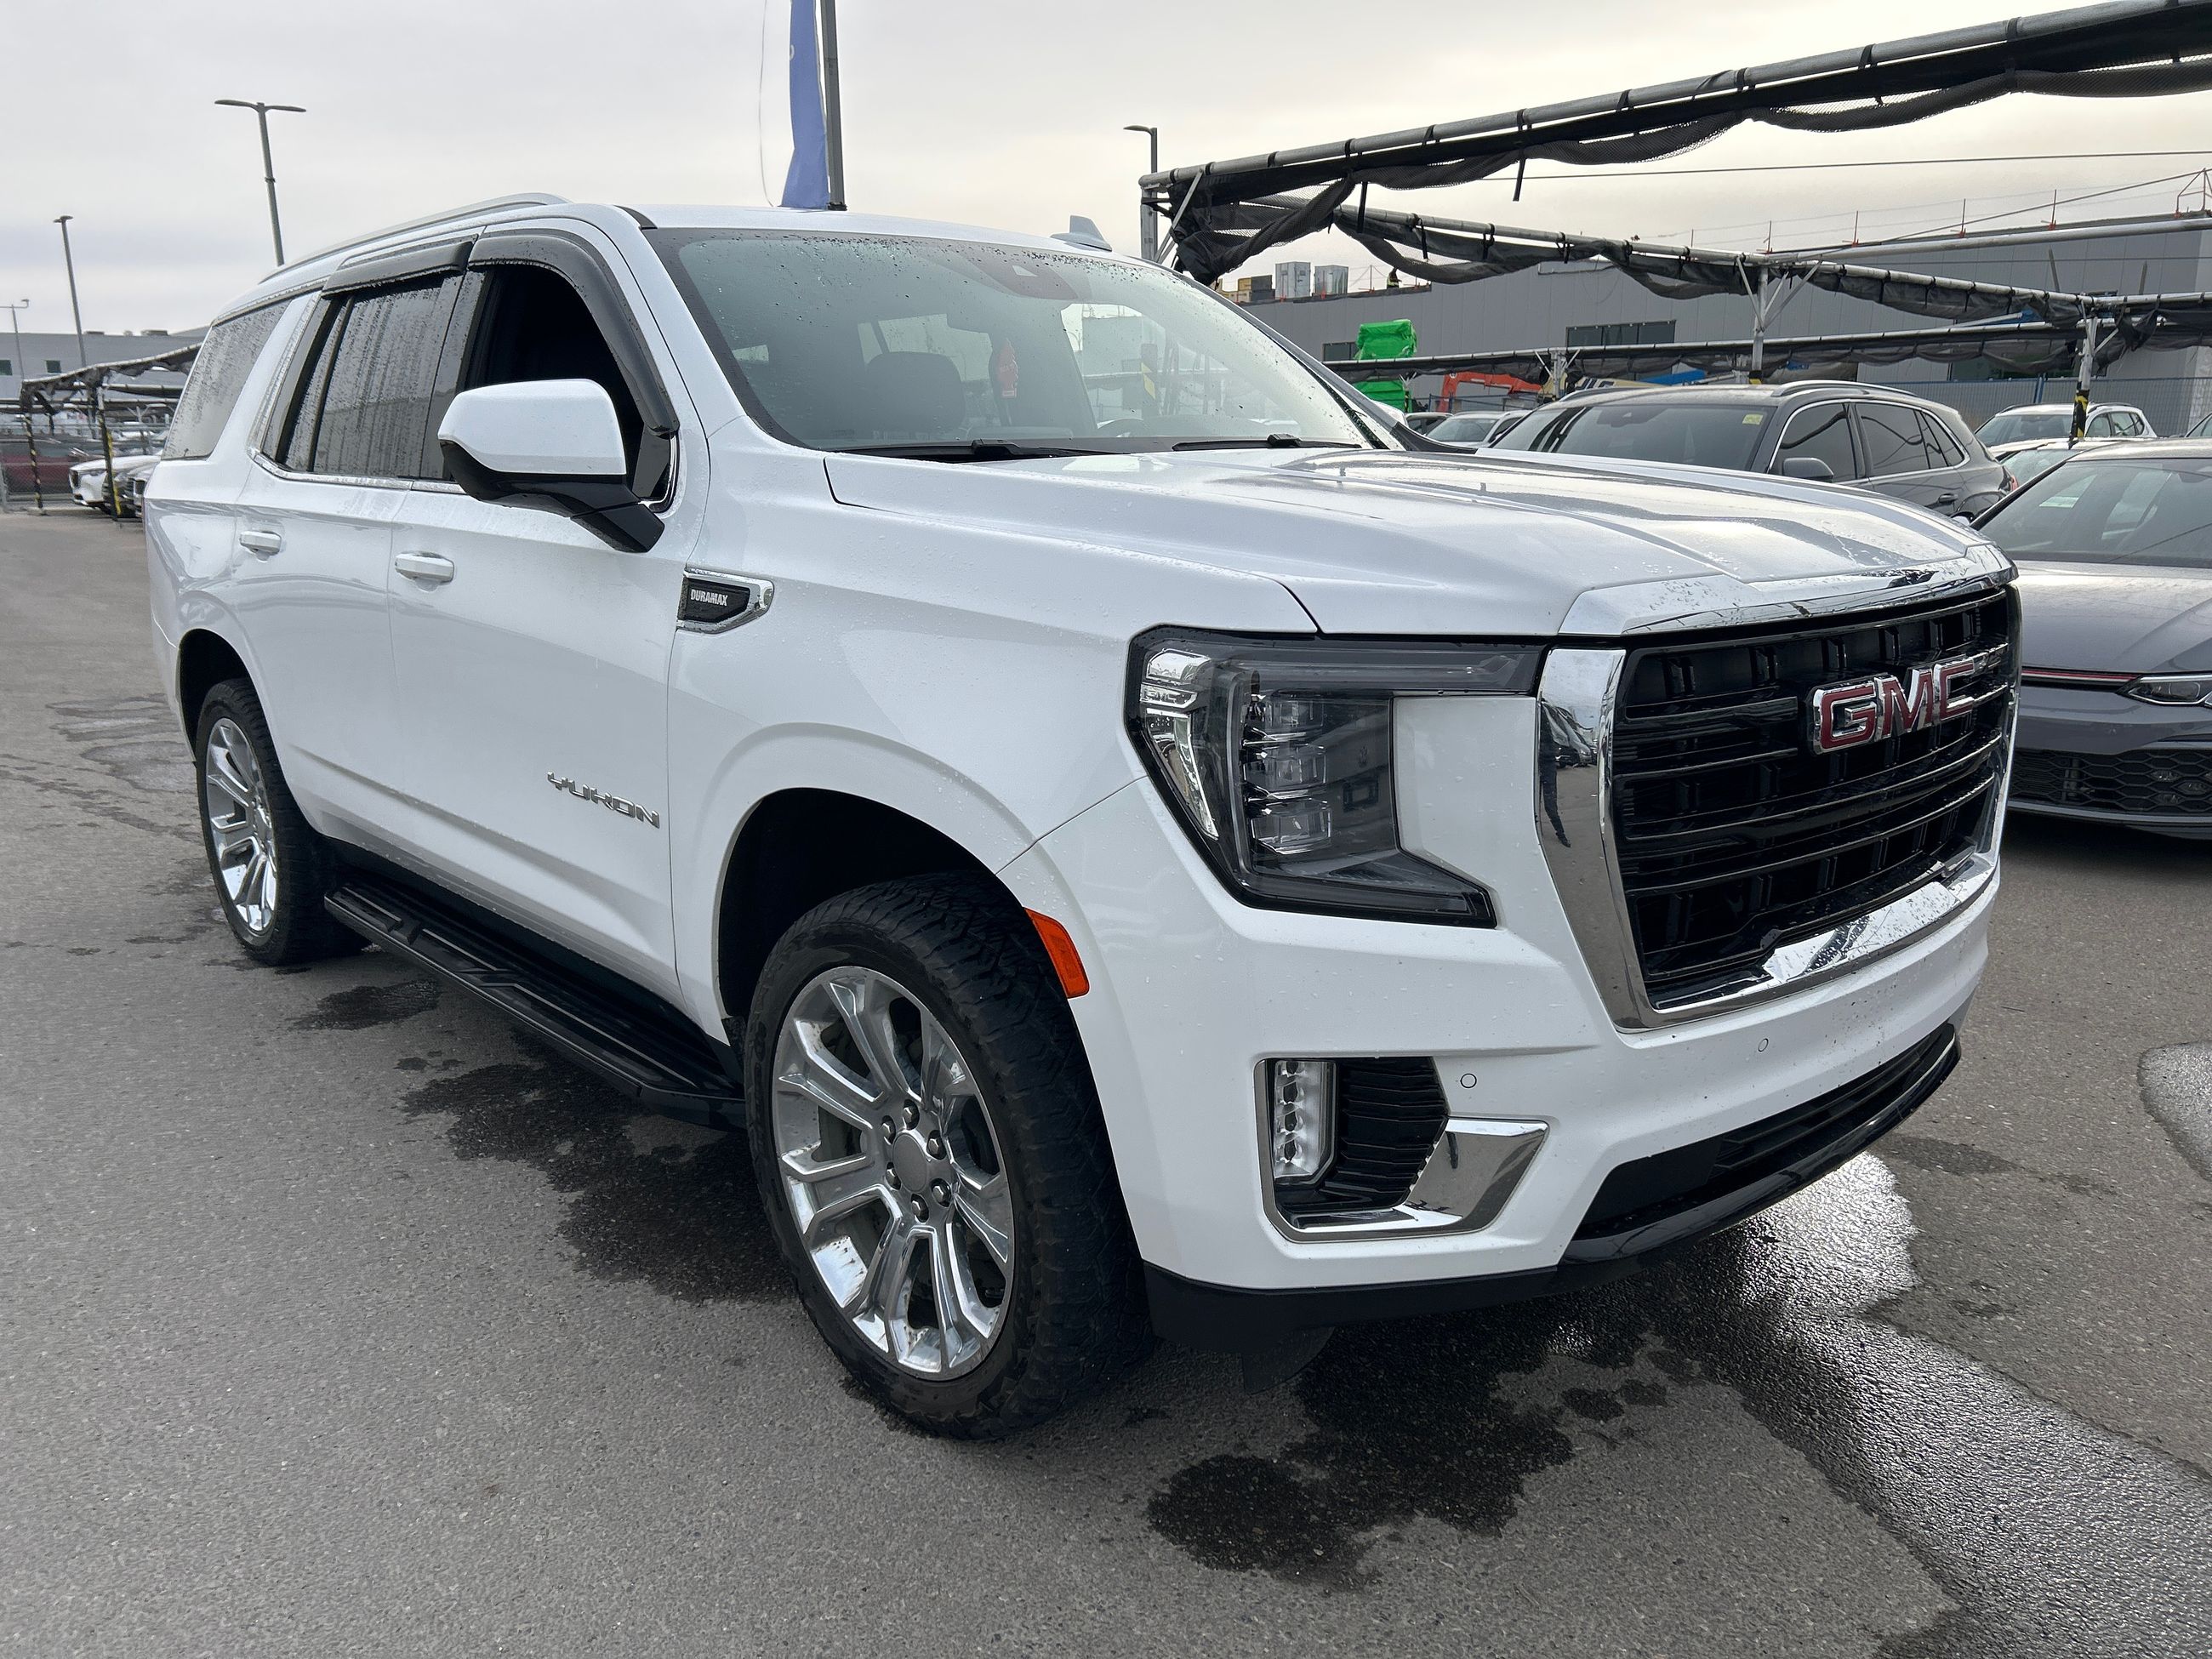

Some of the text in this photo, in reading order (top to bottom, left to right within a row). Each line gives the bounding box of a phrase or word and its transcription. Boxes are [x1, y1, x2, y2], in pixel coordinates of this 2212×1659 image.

[690, 589, 728, 607] DURAMAX
[1811, 658, 1975, 755] GMC
[547, 771, 659, 829] YUKON
